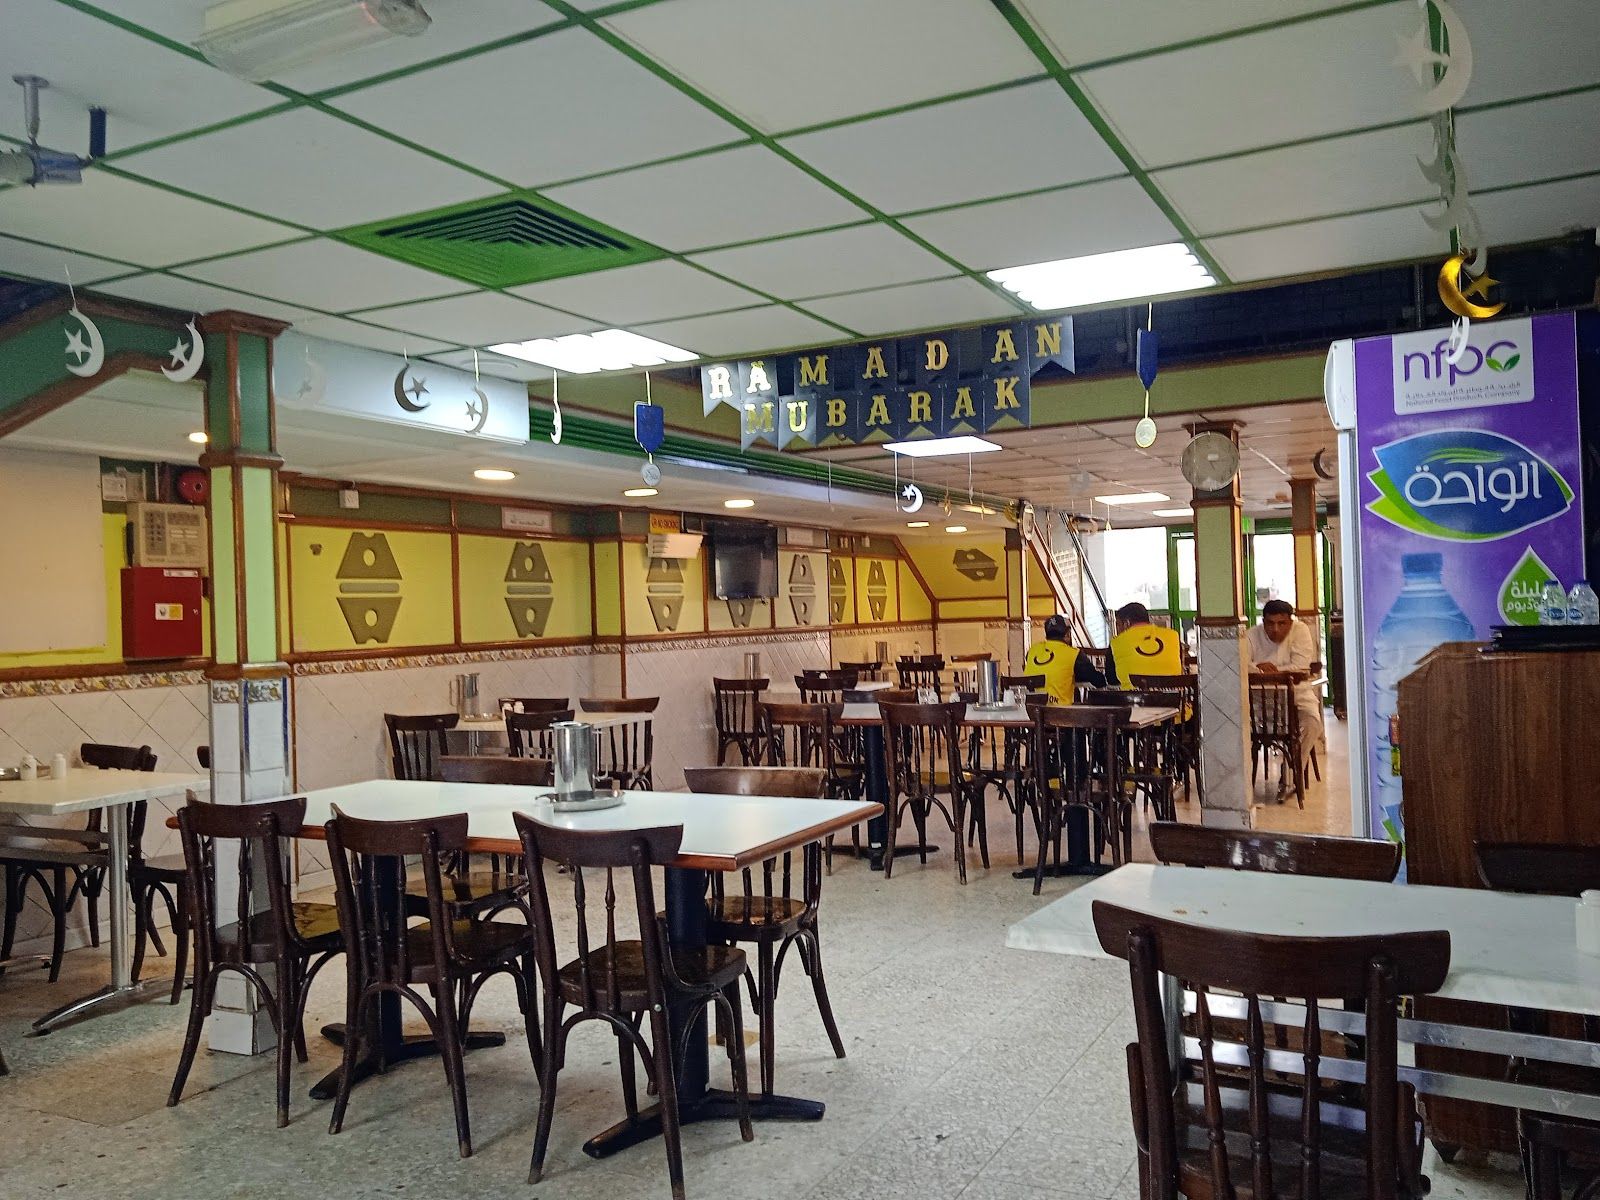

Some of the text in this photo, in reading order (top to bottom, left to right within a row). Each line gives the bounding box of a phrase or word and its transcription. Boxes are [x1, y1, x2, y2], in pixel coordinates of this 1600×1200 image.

[708, 321, 1063, 399] RAMADAN
[1403, 338, 1521, 387] nfpc
[744, 375, 1021, 434] MUBARAK
[1404, 461, 1542, 513] الواحة
